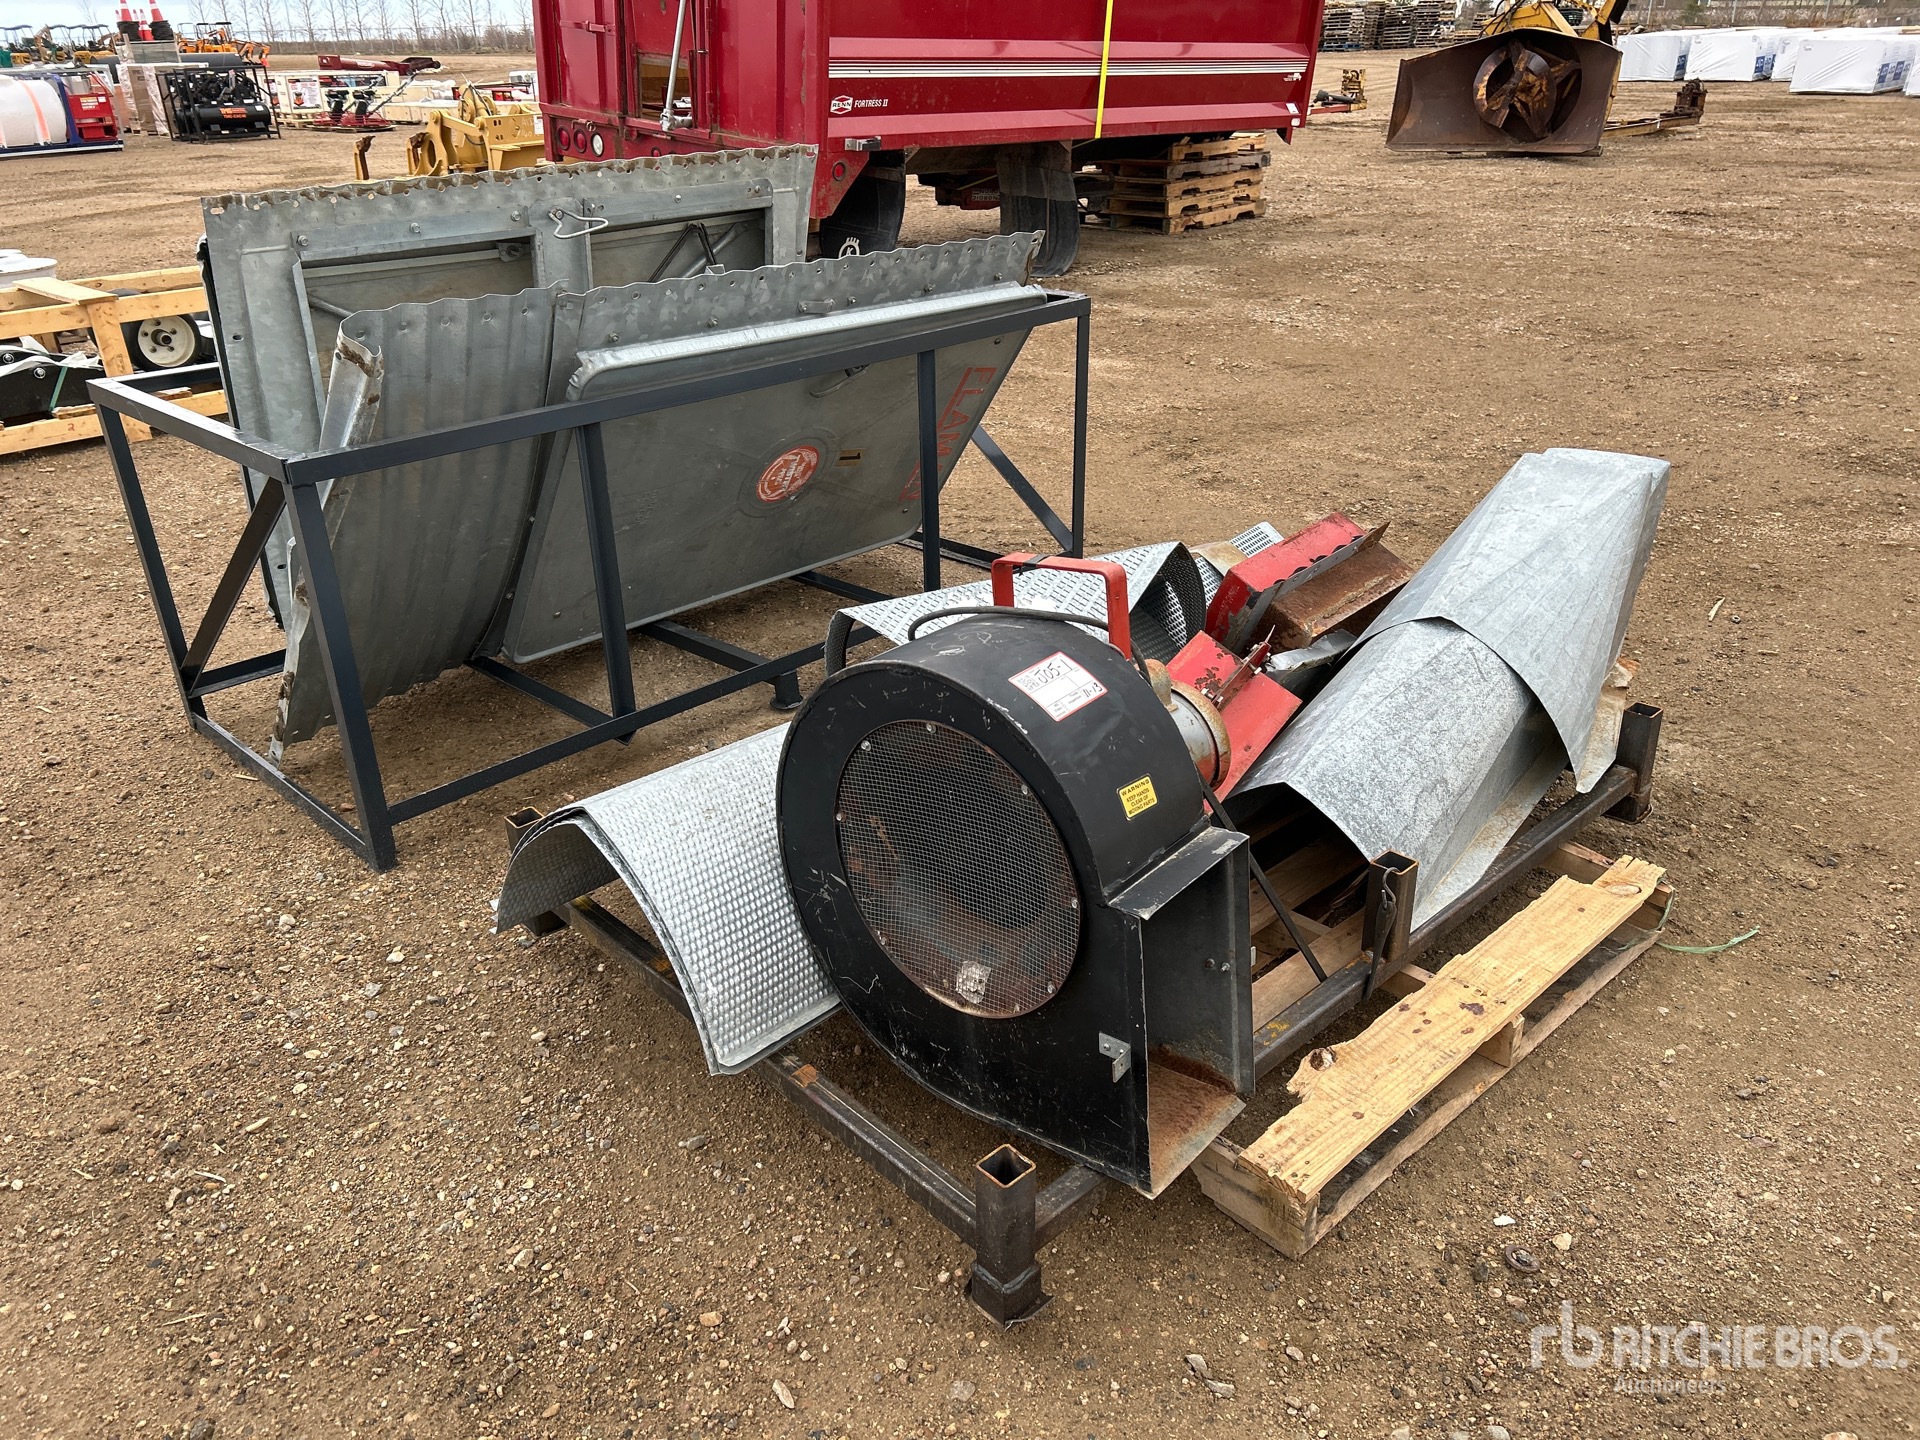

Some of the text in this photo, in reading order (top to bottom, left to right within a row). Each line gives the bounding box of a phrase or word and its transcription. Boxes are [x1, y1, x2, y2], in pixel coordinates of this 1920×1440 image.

[854, 99, 882, 108] FORTRESS
[904, 366, 997, 500] FLAMN
[1120, 778, 1150, 796] WARNING
[1126, 787, 1150, 802] KEEP HANDS
[1128, 797, 1156, 815] MOVING PARTS
[1130, 797, 1143, 807] CLEAR
